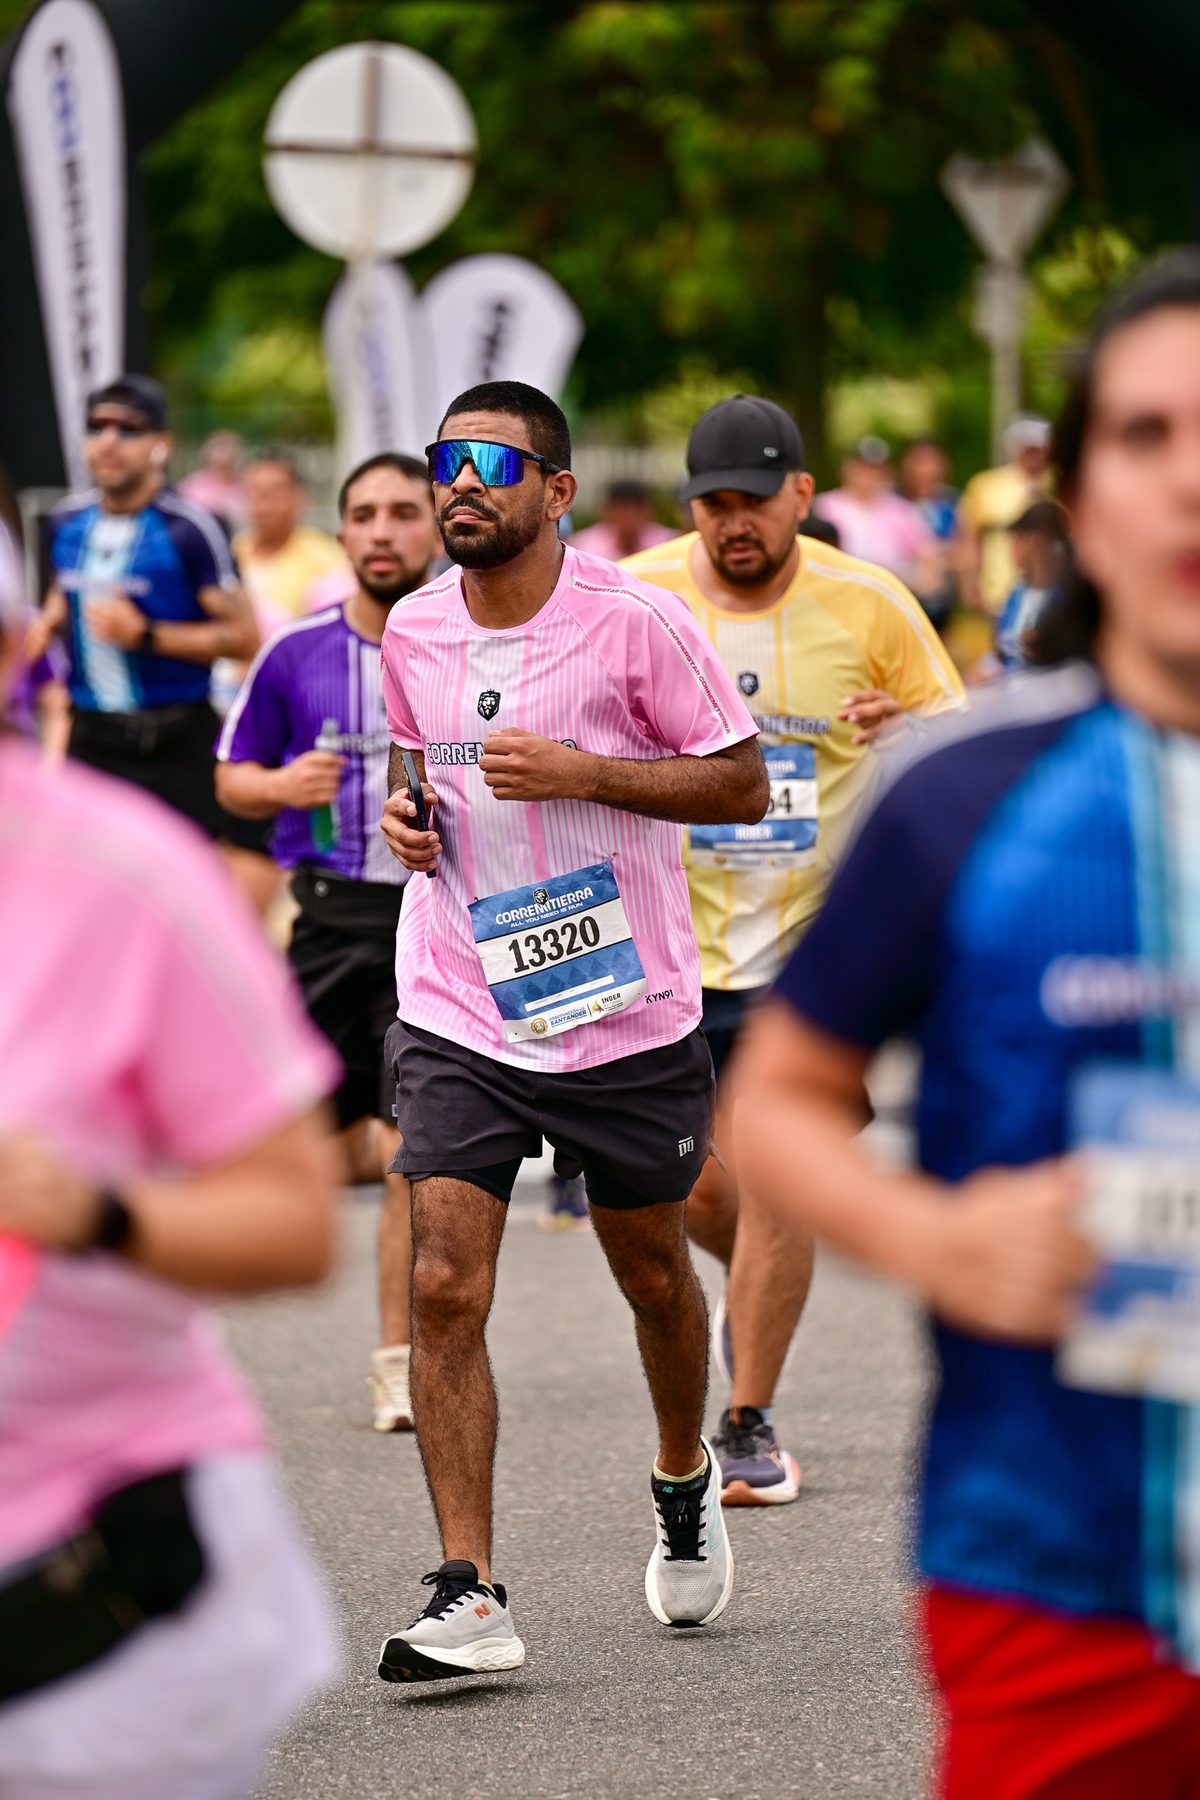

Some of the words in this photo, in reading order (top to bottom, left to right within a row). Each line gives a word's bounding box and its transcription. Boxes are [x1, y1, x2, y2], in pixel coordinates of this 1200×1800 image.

[496, 887, 594, 925] CORREMITIERRA
[510, 920, 524, 928] ALL
[540, 910, 560, 919] NEED
[568, 902, 583, 910] RUN
[508, 915, 600, 973] 13320
[601, 992, 622, 1004] INDER
[550, 1010, 587, 1026] SANTANDER
